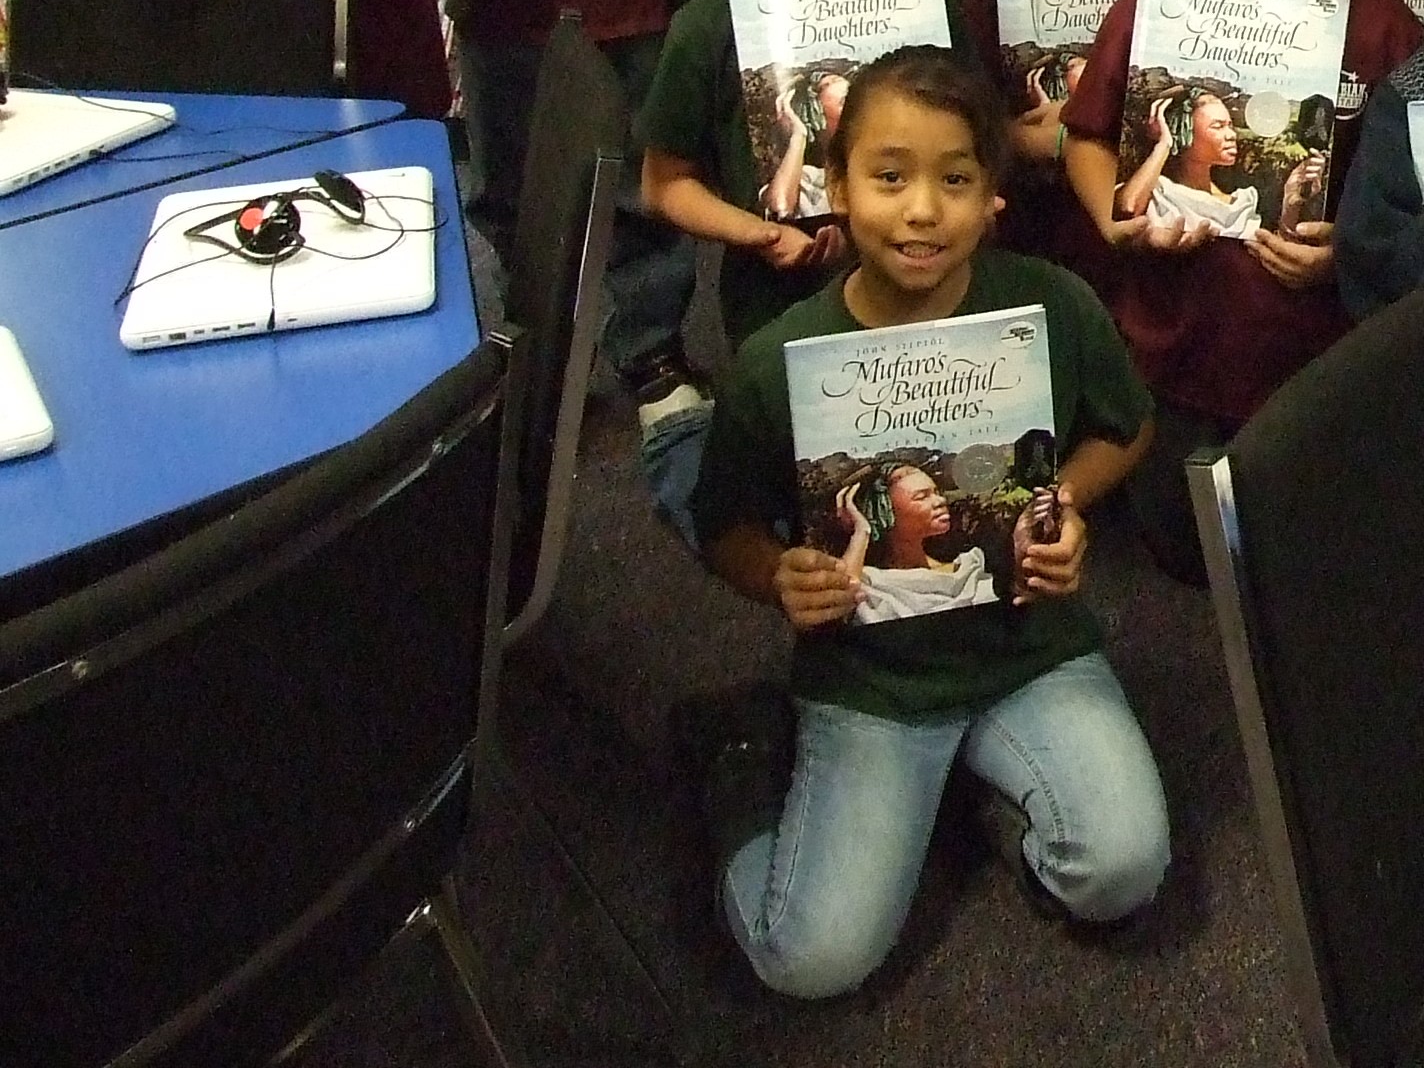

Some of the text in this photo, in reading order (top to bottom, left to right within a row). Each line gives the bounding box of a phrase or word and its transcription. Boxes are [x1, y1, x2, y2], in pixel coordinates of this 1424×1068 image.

[788, 17, 900, 53] Daughters
[1186, 12, 1318, 52] Beautiful
[1179, 35, 1289, 81] Daughters
[822, 351, 948, 397] Mufaro's
[859, 357, 1021, 405] Beautiful
[855, 399, 992, 443] Daughters
